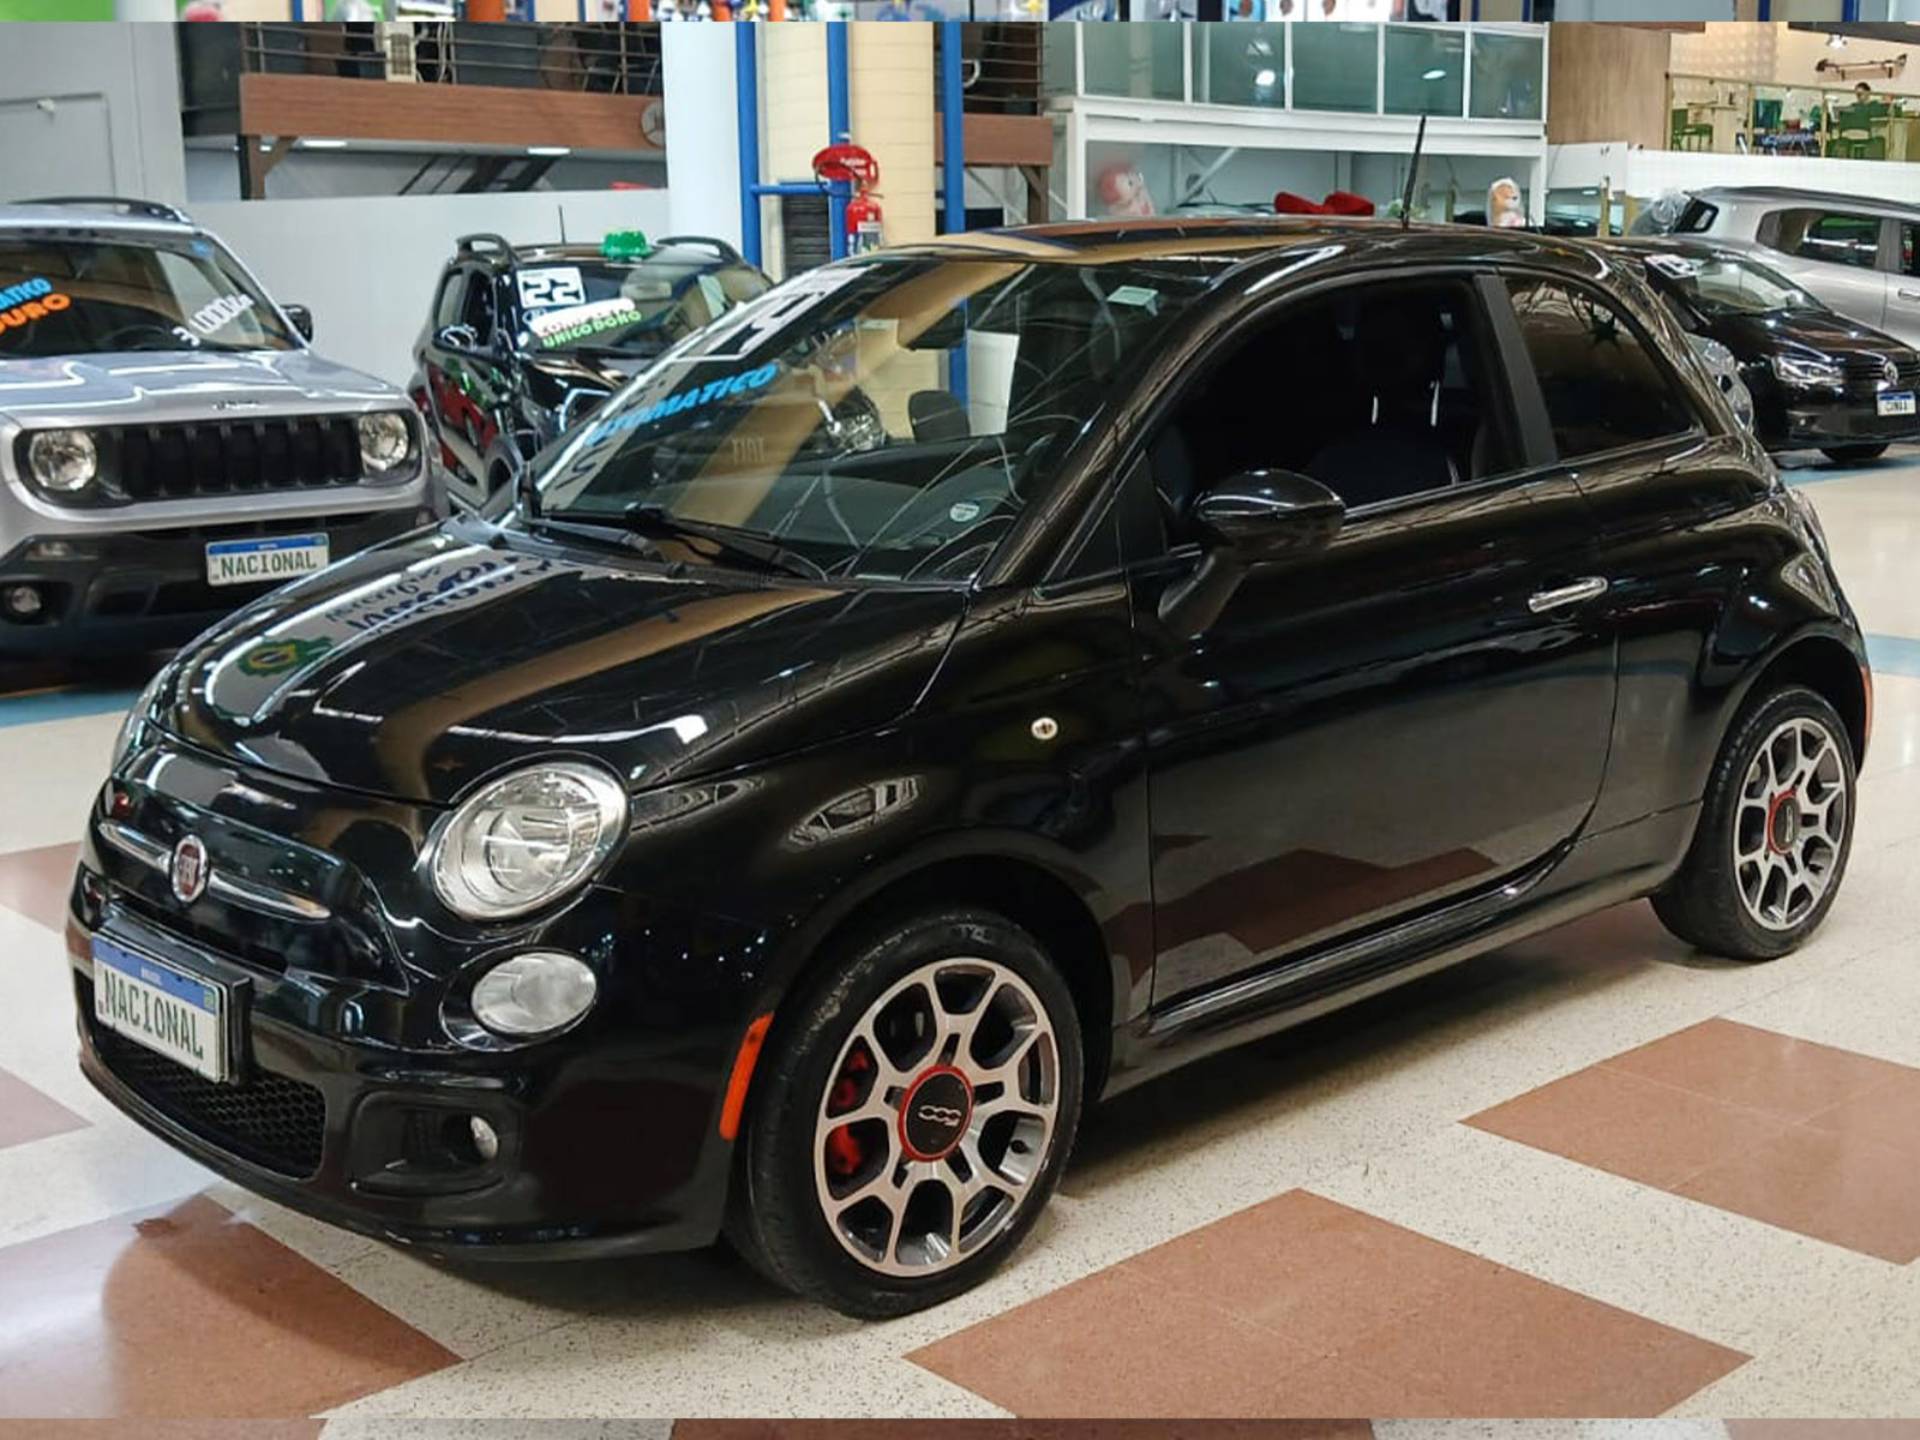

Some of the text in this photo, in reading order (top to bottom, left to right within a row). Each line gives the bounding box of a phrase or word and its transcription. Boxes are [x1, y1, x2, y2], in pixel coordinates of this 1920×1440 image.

[523, 278, 582, 302] 22
[221, 550, 318, 578] NACIONAL
[104, 968, 205, 1061] NACIONAL
